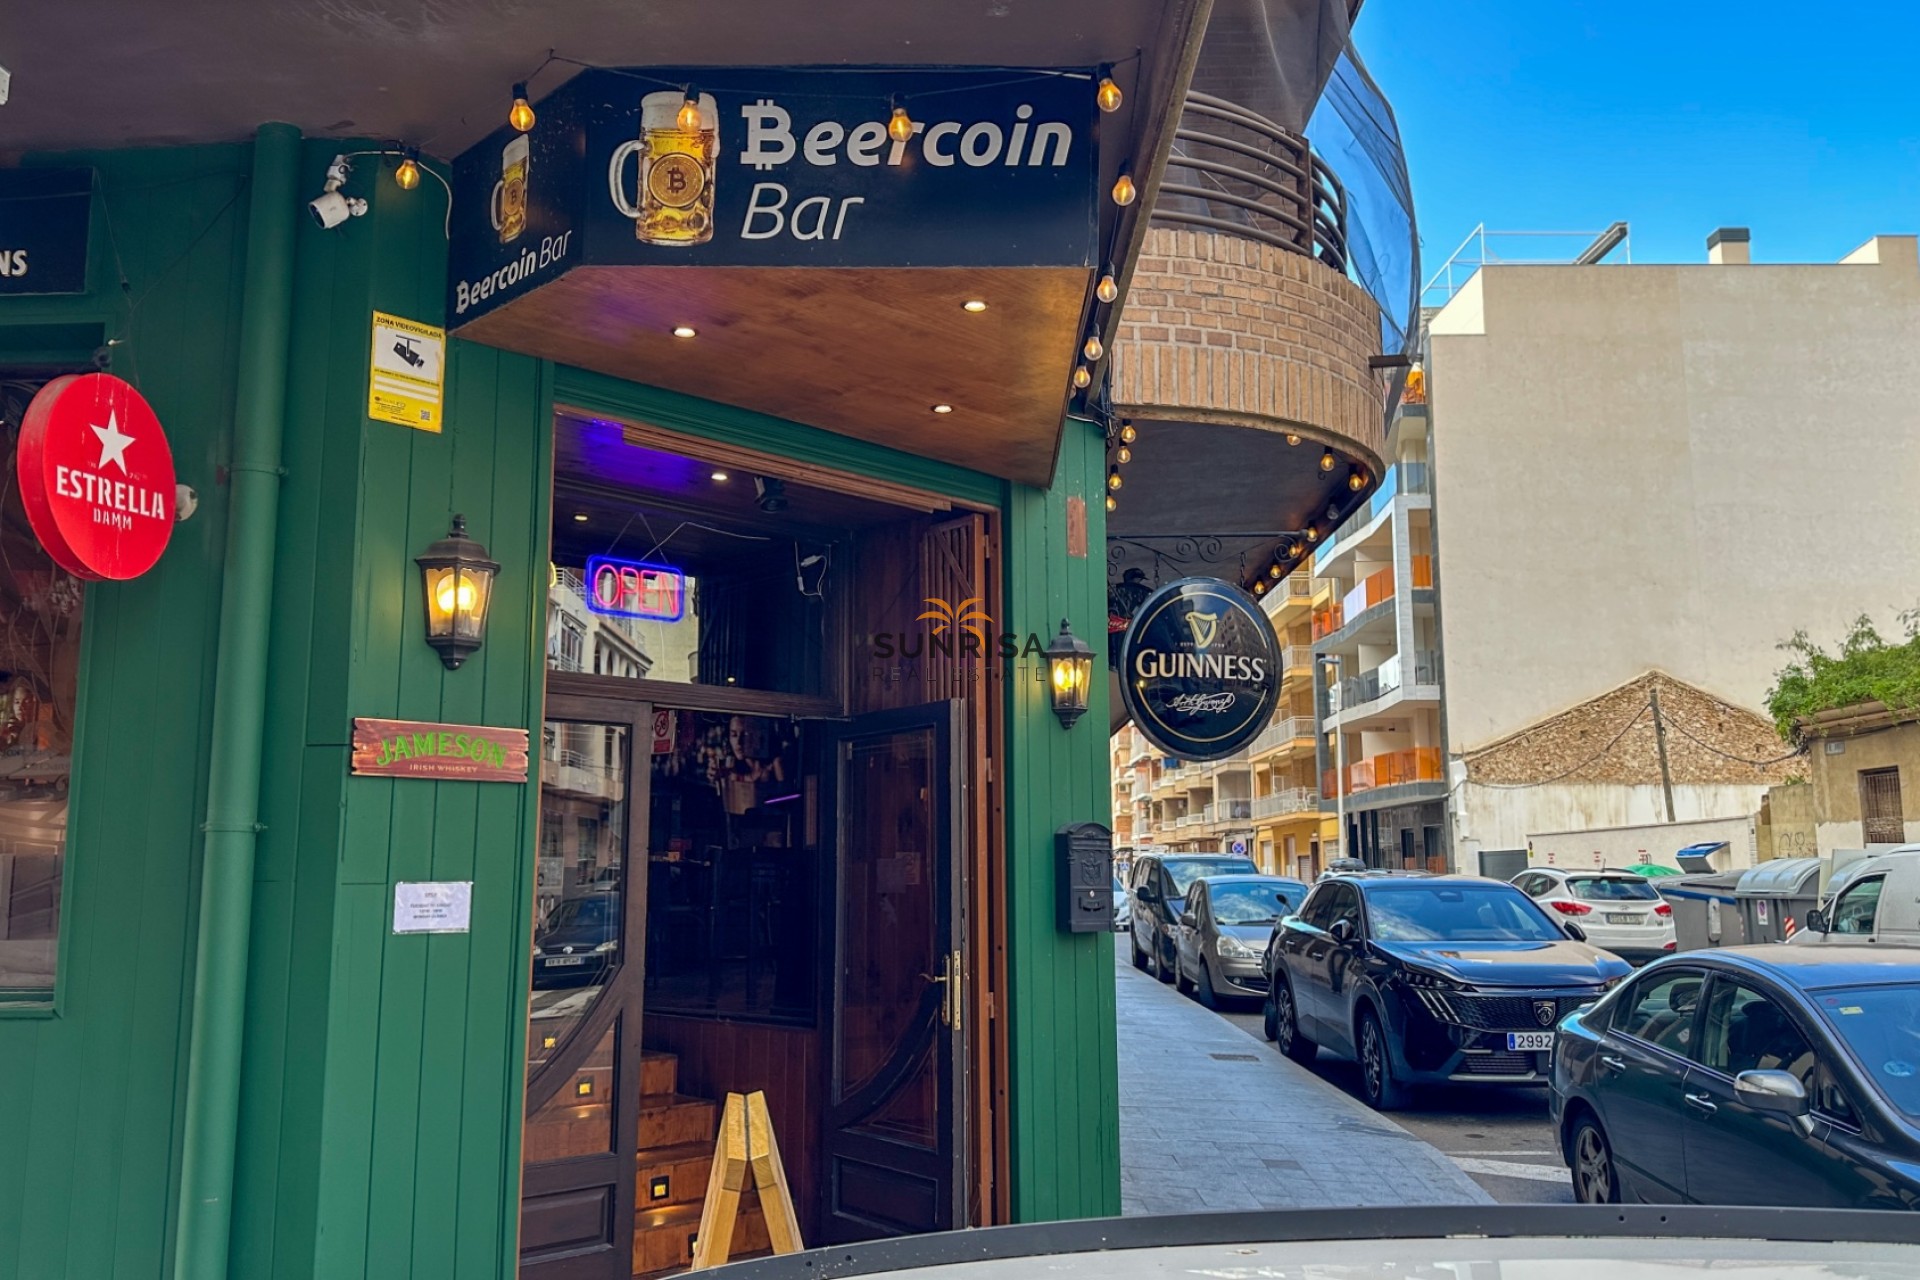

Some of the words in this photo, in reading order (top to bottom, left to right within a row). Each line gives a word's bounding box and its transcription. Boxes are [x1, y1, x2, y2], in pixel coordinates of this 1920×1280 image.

[741, 182, 865, 240] Bar
[456, 247, 537, 314] Beercoin
[539, 230, 572, 269] Bar
[376, 316, 394, 326] ZONA
[395, 320, 442, 339] VIDEOVIGILADA
[56, 464, 166, 520] ESTRELLA
[93, 508, 132, 531] DAMM
[594, 564, 680, 616] OPEN
[1135, 649, 1265, 682] GUINNESS
[376, 731, 508, 769] JAMESON
[409, 763, 435, 772] IRISH
[437, 765, 478, 774] WHISKEY
[1517, 1034, 1552, 1049] 2992
